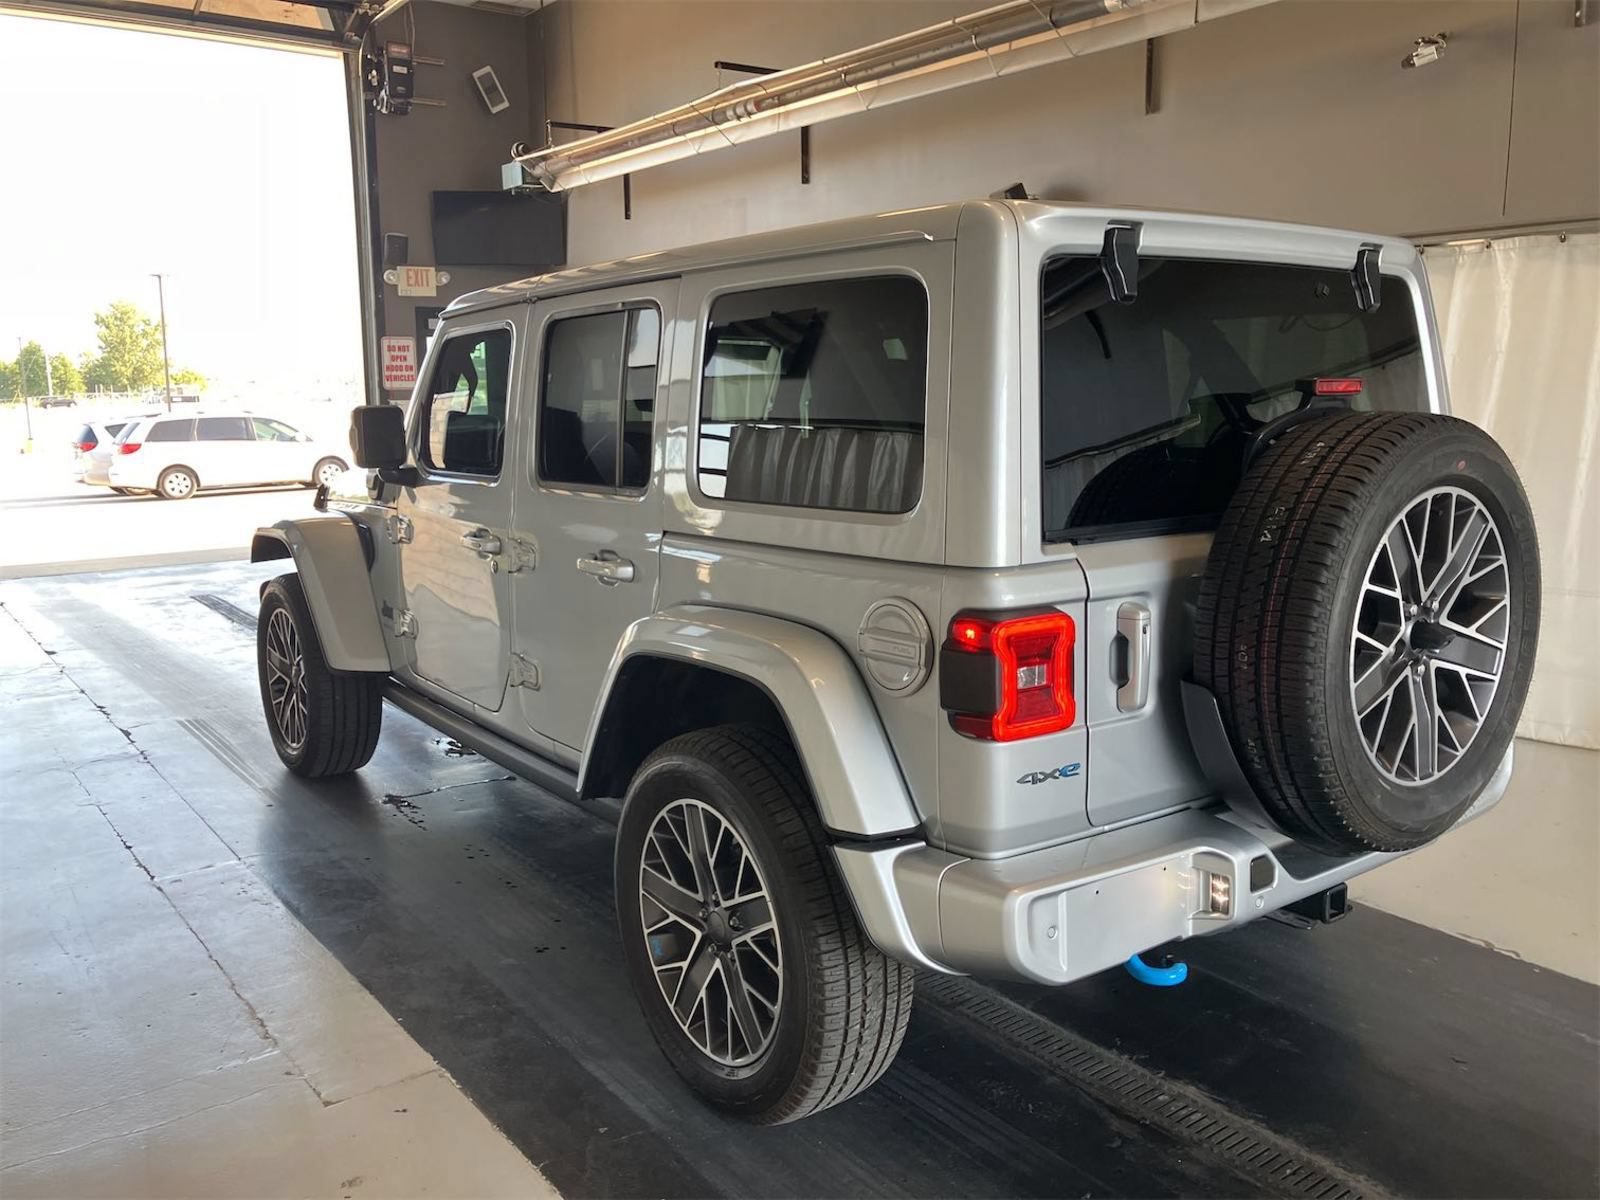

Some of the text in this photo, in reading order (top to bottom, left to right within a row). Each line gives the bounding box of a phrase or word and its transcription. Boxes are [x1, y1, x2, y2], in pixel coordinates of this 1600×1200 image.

[406, 268, 432, 287] EXIT
[386, 344, 410, 352] DO NOT
[391, 354, 407, 362] OPEN
[386, 364, 414, 372] HOOD ON
[385, 374, 416, 382] VEHICLES
